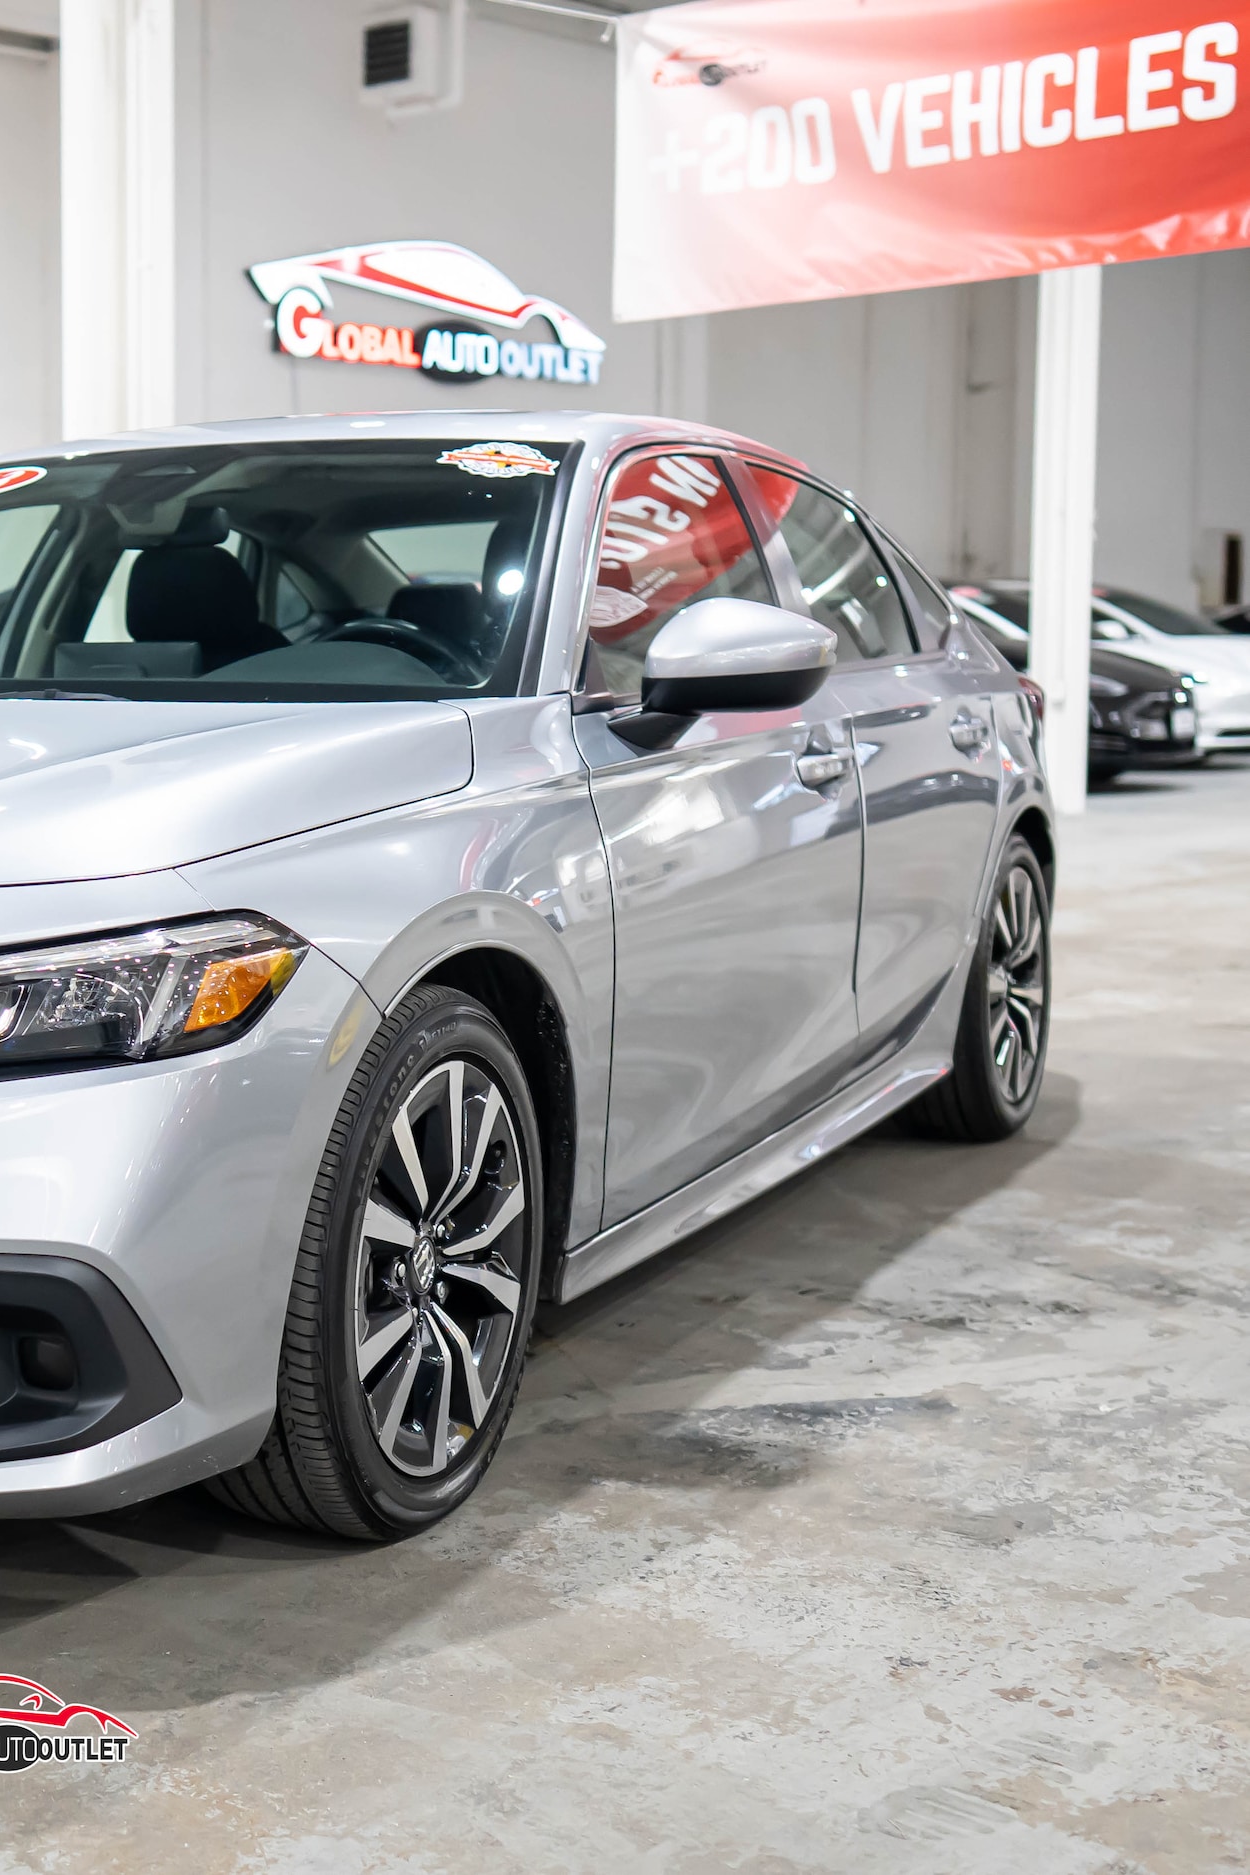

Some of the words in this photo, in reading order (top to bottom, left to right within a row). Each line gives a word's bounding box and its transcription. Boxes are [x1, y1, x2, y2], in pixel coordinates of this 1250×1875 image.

[651, 97, 837, 195] +200
[852, 21, 1239, 174] VEHICLES
[276, 288, 421, 368] GLOBAL
[422, 329, 499, 376] AUTO
[500, 338, 603, 384] OUTLET
